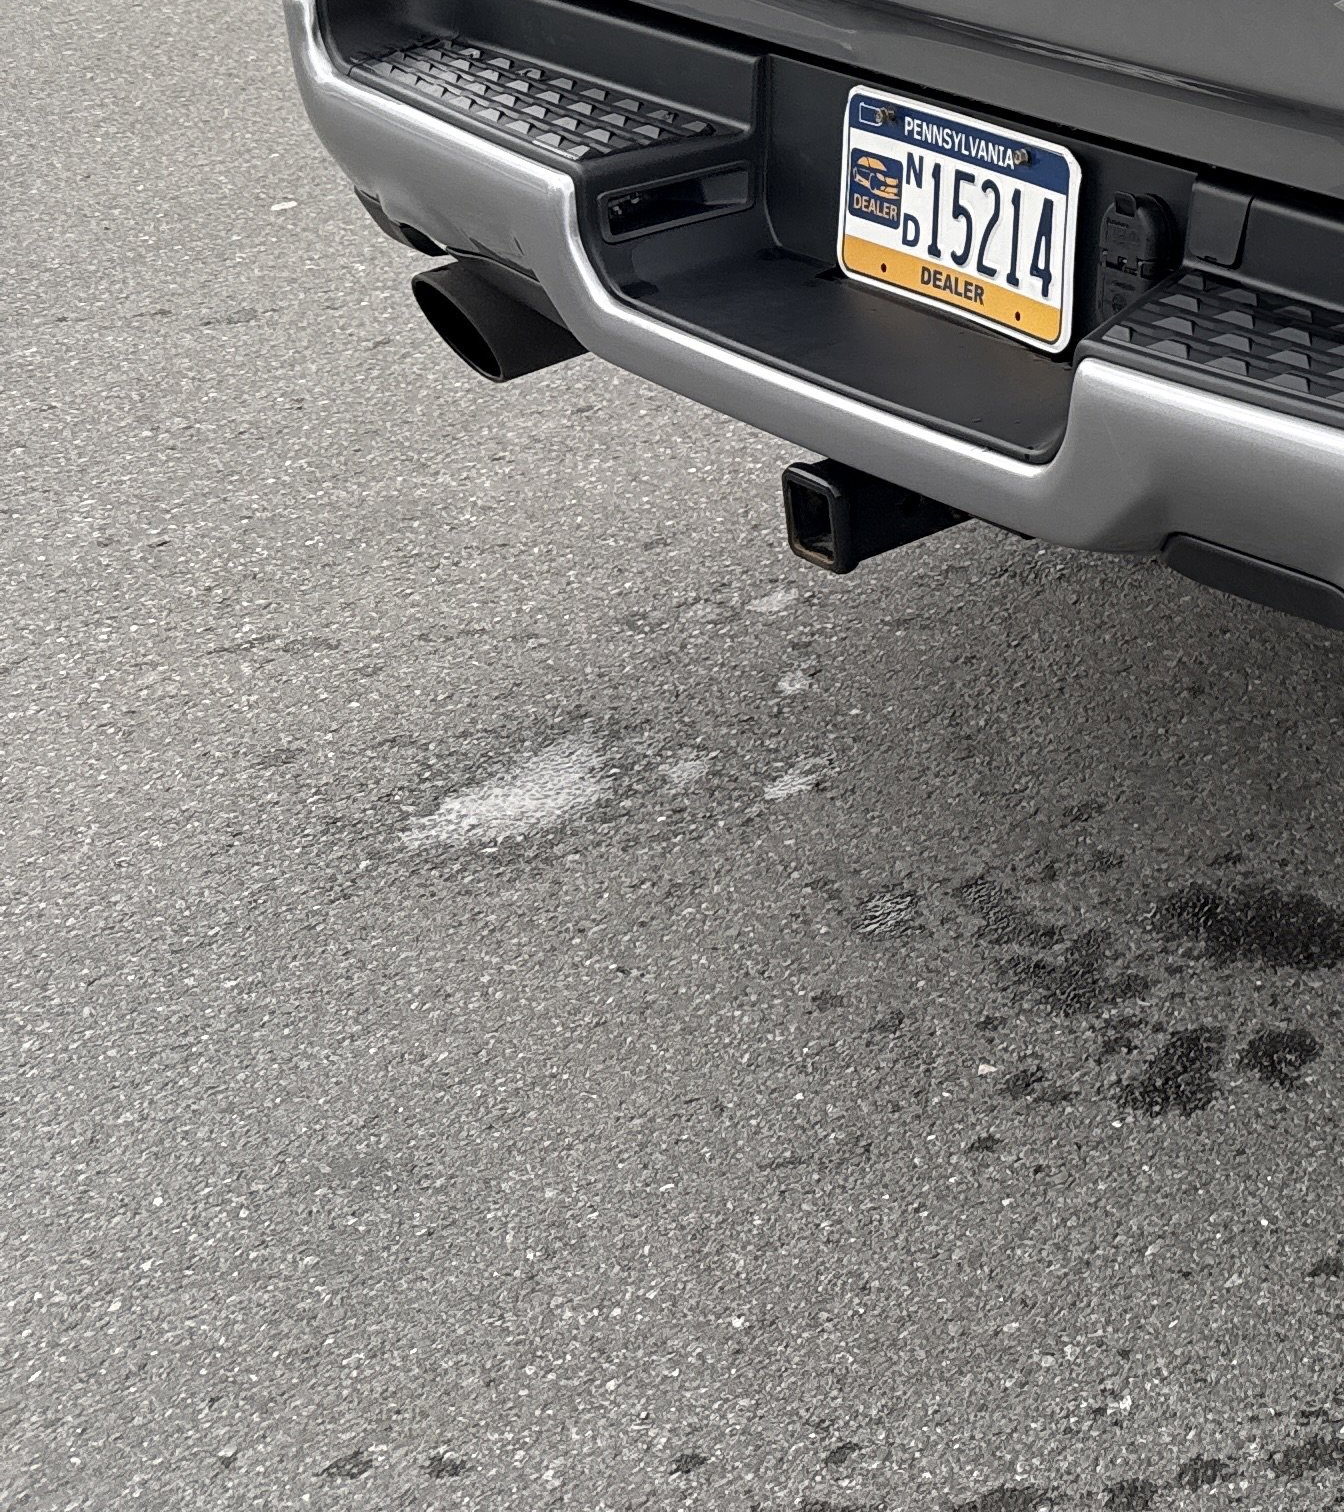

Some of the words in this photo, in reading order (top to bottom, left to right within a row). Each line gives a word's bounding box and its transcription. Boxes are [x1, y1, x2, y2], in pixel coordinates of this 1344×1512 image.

[904, 116, 1016, 170] PENNSYLVANIA
[852, 192, 898, 222] DEALER
[920, 265, 985, 306] DEALER
